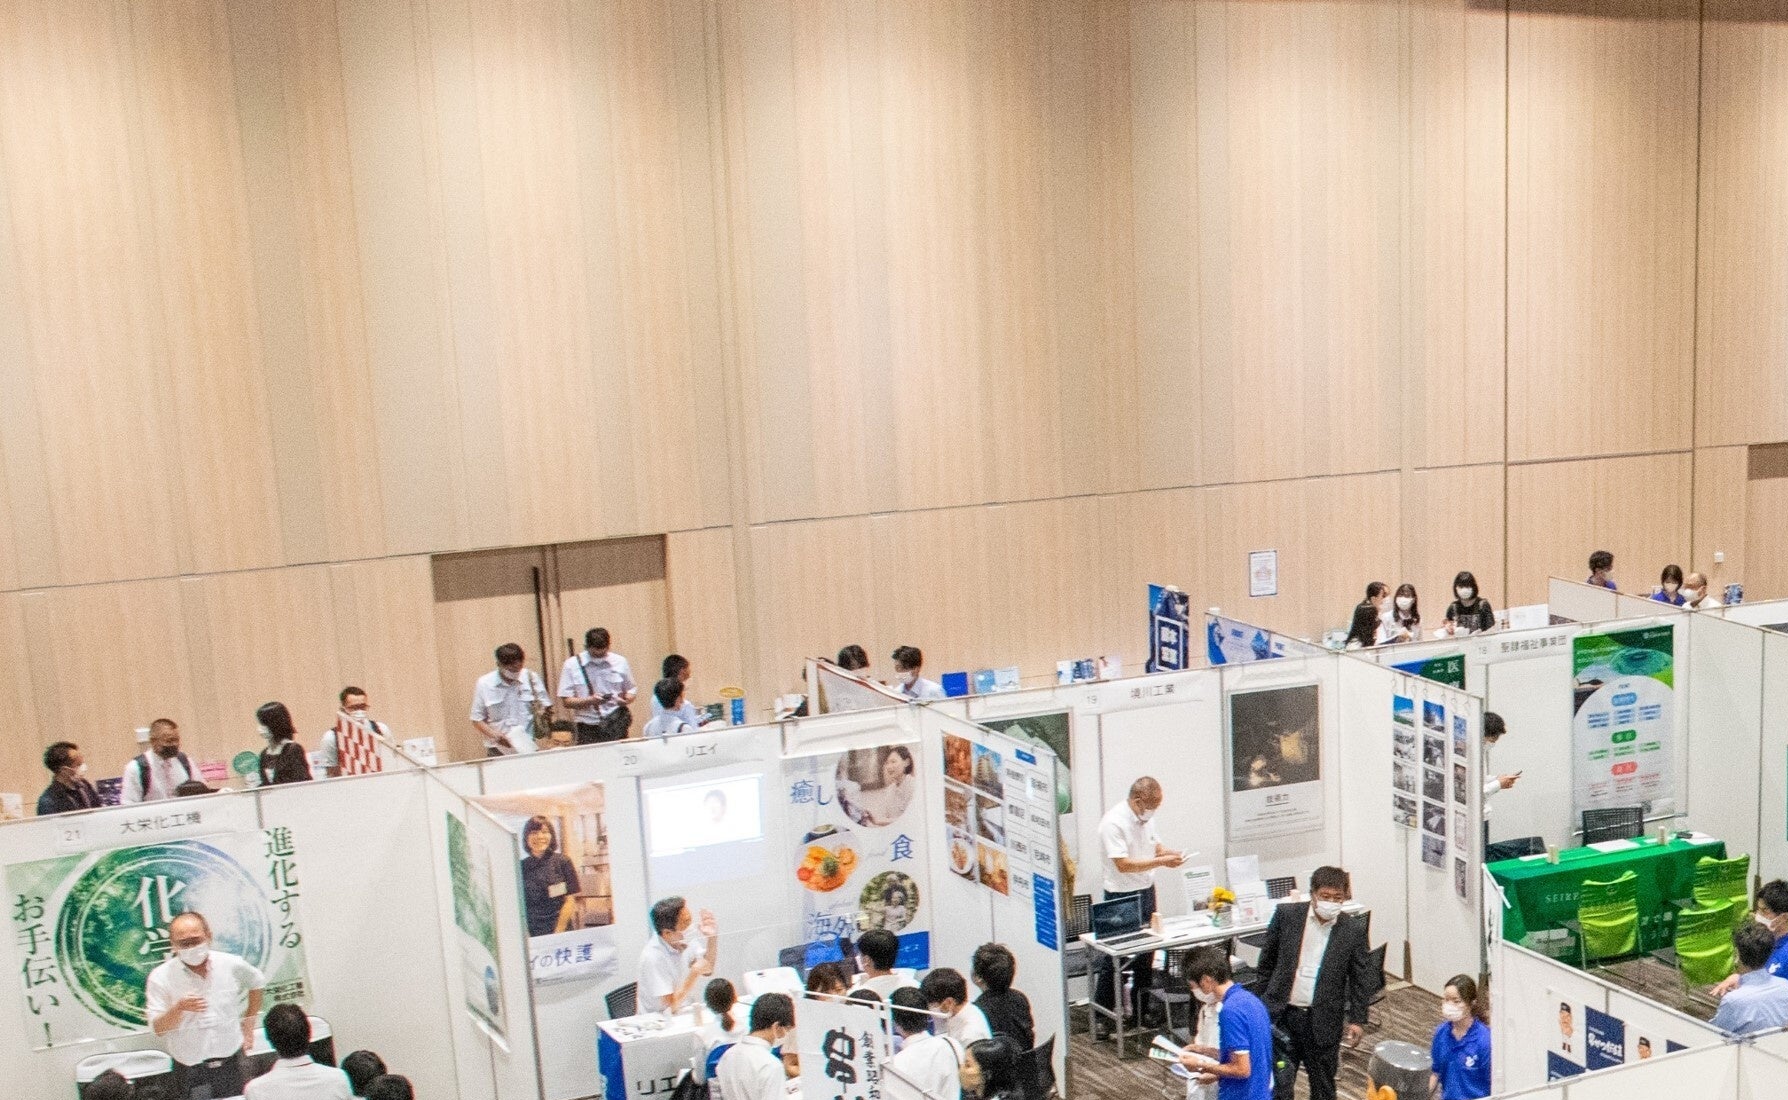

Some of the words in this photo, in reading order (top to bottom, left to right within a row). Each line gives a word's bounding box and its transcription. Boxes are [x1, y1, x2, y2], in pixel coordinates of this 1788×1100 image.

[790, 780, 833, 806] 癒し
[119, 810, 202, 835] 大栄化工機
[890, 833, 914, 862] 食
[264, 826, 303, 950] 進化する
